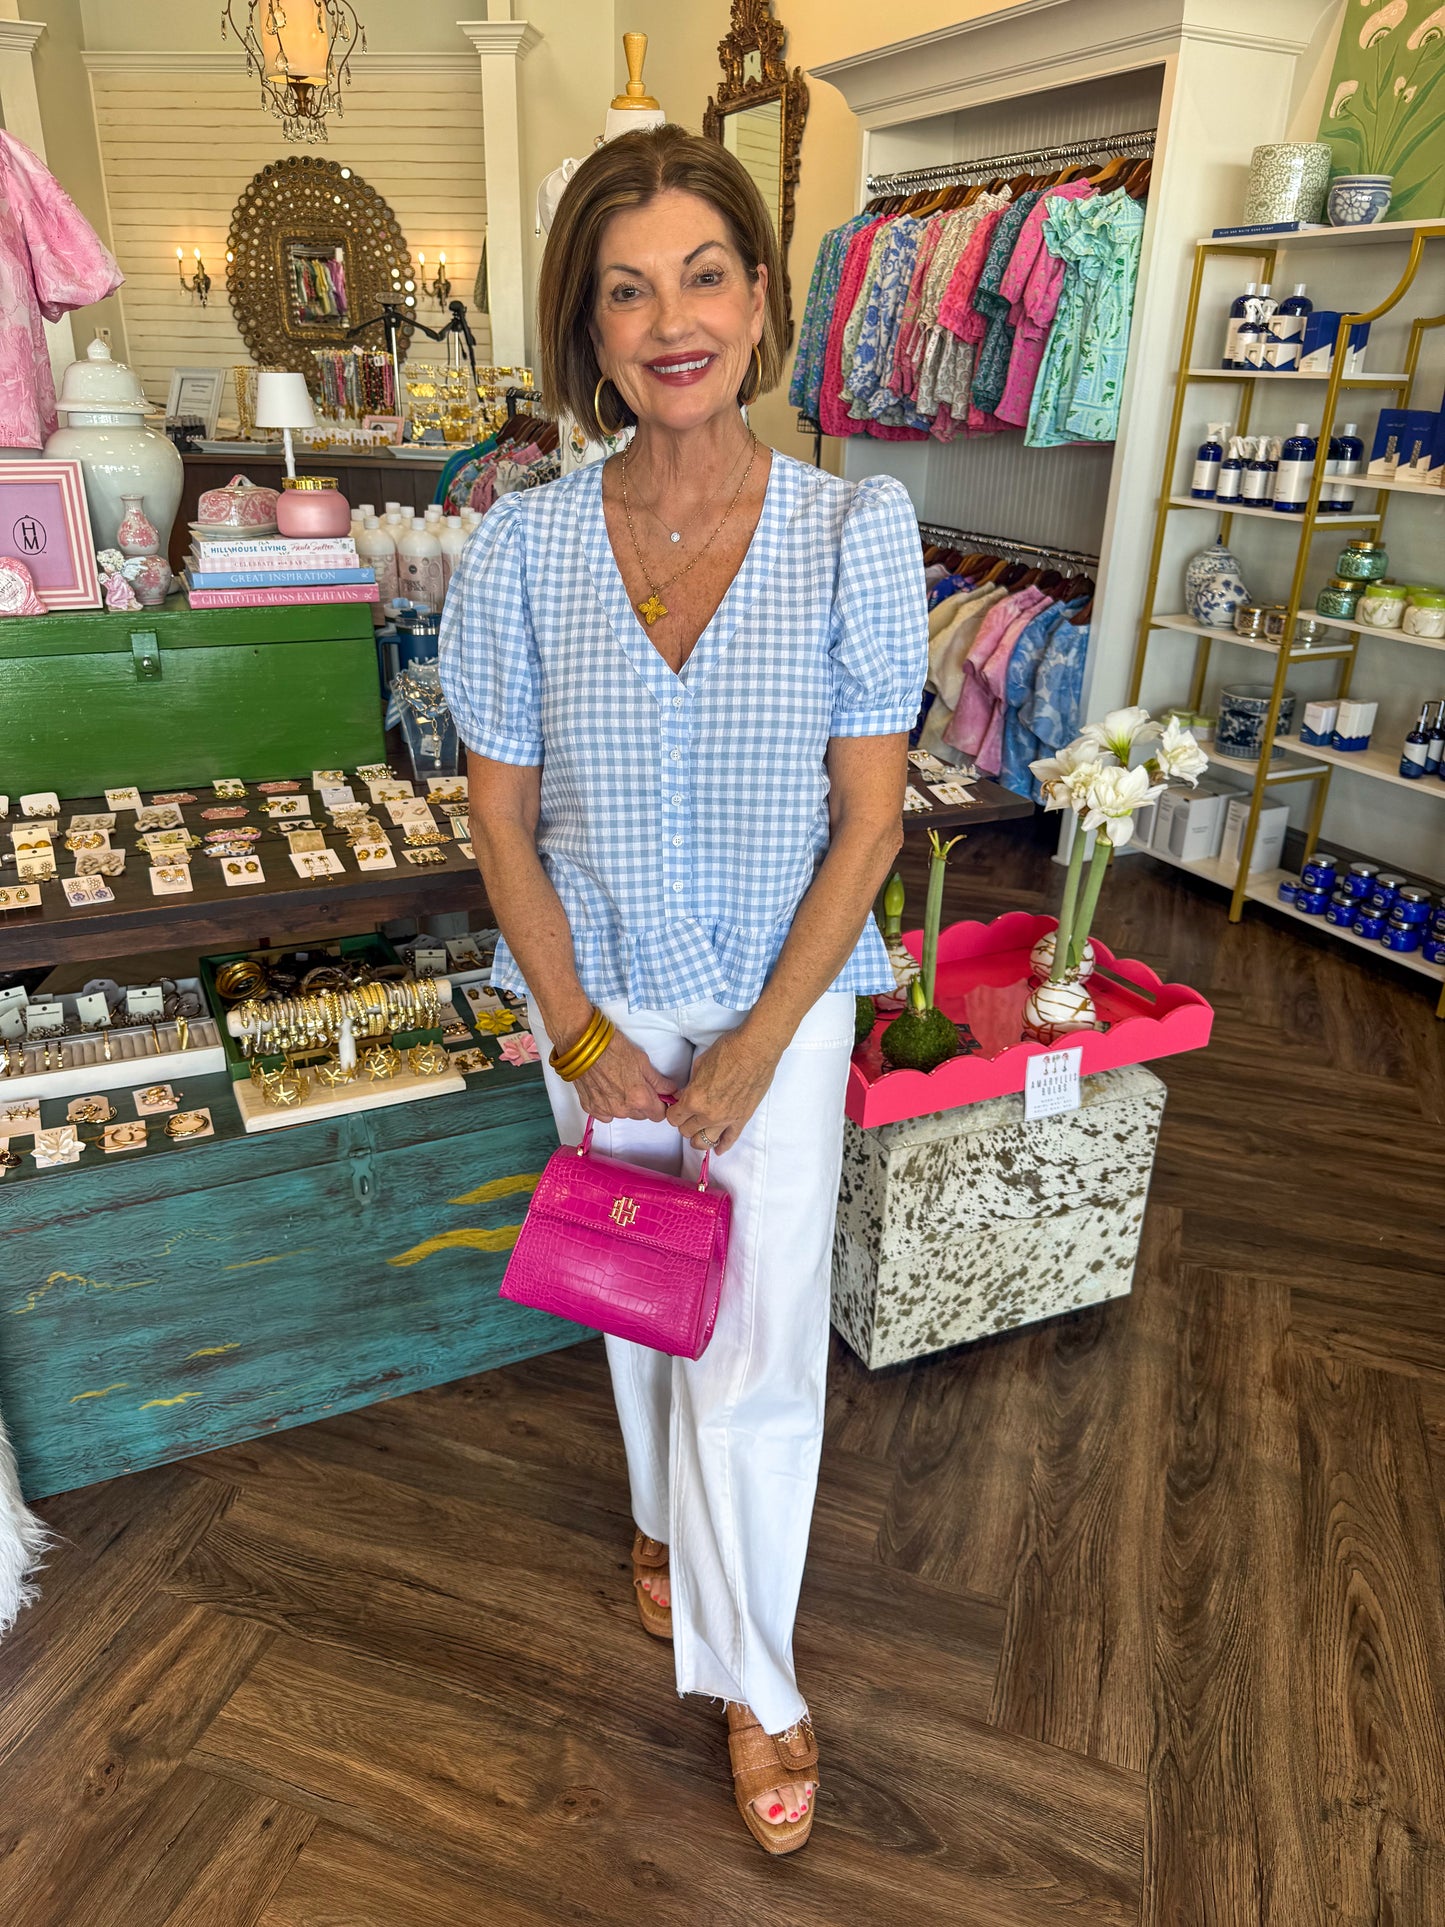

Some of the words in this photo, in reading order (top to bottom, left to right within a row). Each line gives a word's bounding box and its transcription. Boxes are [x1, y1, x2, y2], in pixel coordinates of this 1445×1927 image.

[210, 546, 229, 554] HILL
[231, 545, 257, 553] HOUSE
[234, 560, 274, 568] CELEBRATE
[230, 573, 264, 583] GREAT
[269, 571, 336, 582] INSPIRATION
[201, 593, 264, 605] CHARLOTTE
[266, 592, 295, 602] MOSS
[297, 591, 358, 602] ENTERTAINS
[1031, 1072, 1077, 1089] AMARYLLIS
[1041, 1083, 1067, 1096] BULBS
